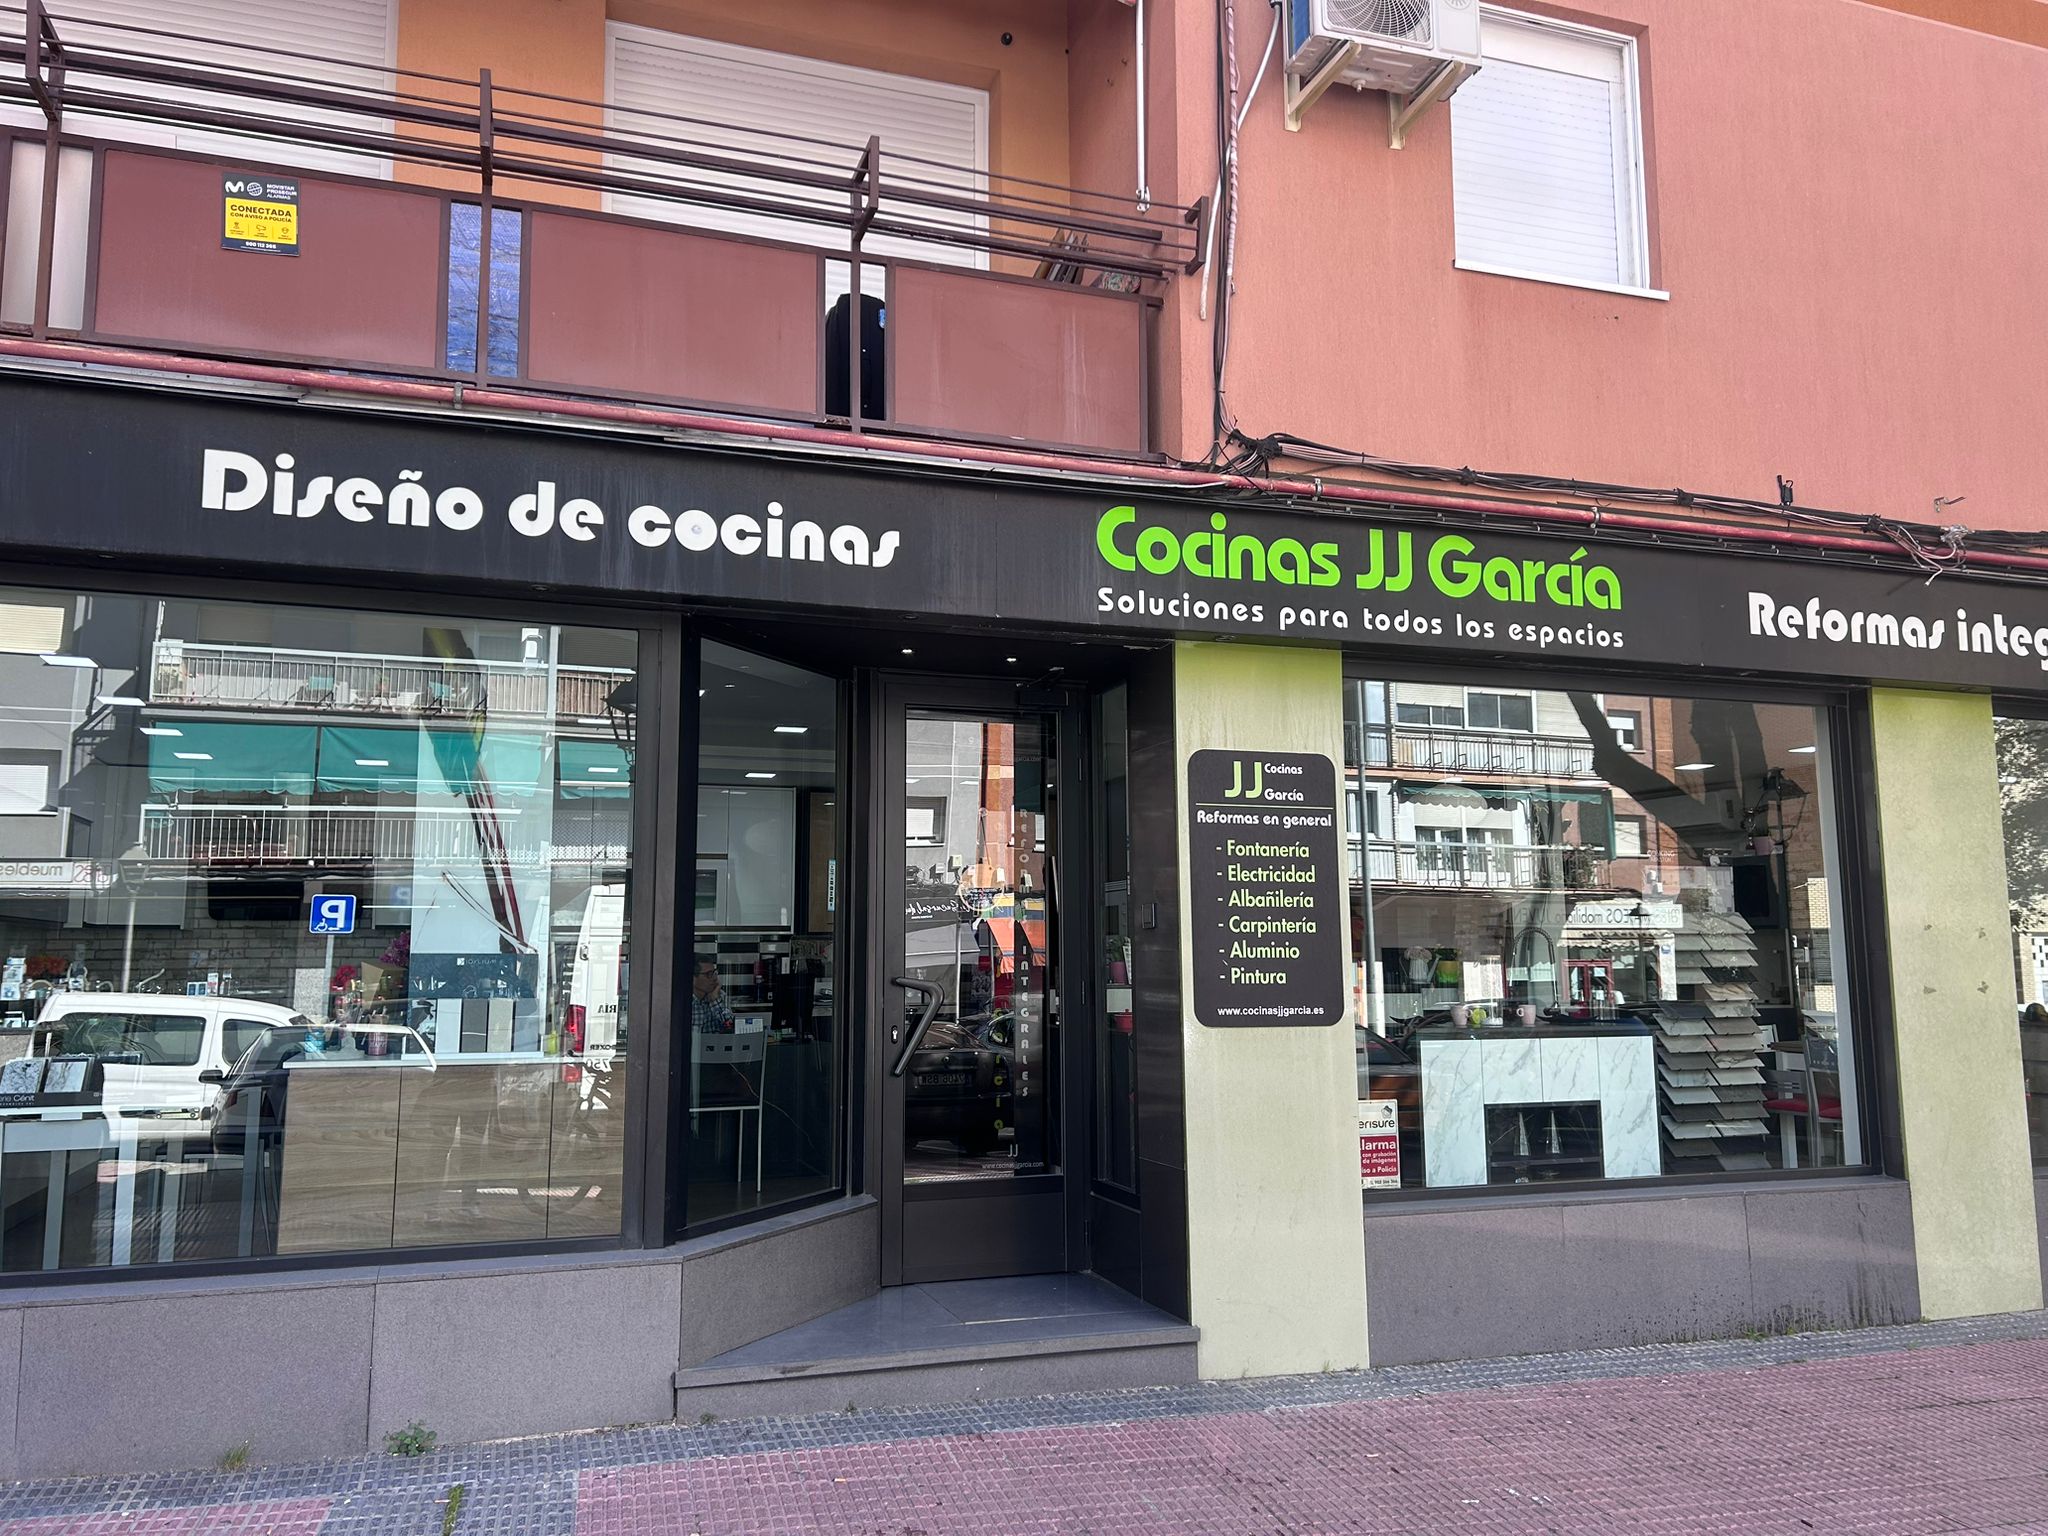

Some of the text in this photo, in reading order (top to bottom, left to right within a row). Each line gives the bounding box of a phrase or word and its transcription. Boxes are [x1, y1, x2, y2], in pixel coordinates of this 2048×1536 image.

[230, 204, 292, 217] CONECTADA
[202, 449, 900, 568] Diseño de cocinas
[1096, 505, 1622, 610] Cocinas JJ García
[1097, 587, 1624, 648] Soluciones para todos los espacios
[1748, 591, 1945, 650] Reformas
[1264, 763, 1303, 775] Cocinas
[1224, 760, 1263, 799] JJ
[1264, 788, 1304, 801] García
[1196, 810, 1332, 829] Reformas en general
[1227, 839, 1310, 858] Fontanería
[1228, 863, 1316, 883] Electricidad
[1228, 889, 1314, 908] Albañilería
[1229, 915, 1317, 938] Carpintería
[1230, 939, 1300, 959] Aluminio
[1231, 967, 1287, 984] Pintura
[1217, 1006, 1325, 1017] www.cocinasjjgarcia.es
[1360, 1139, 1396, 1151] larma
